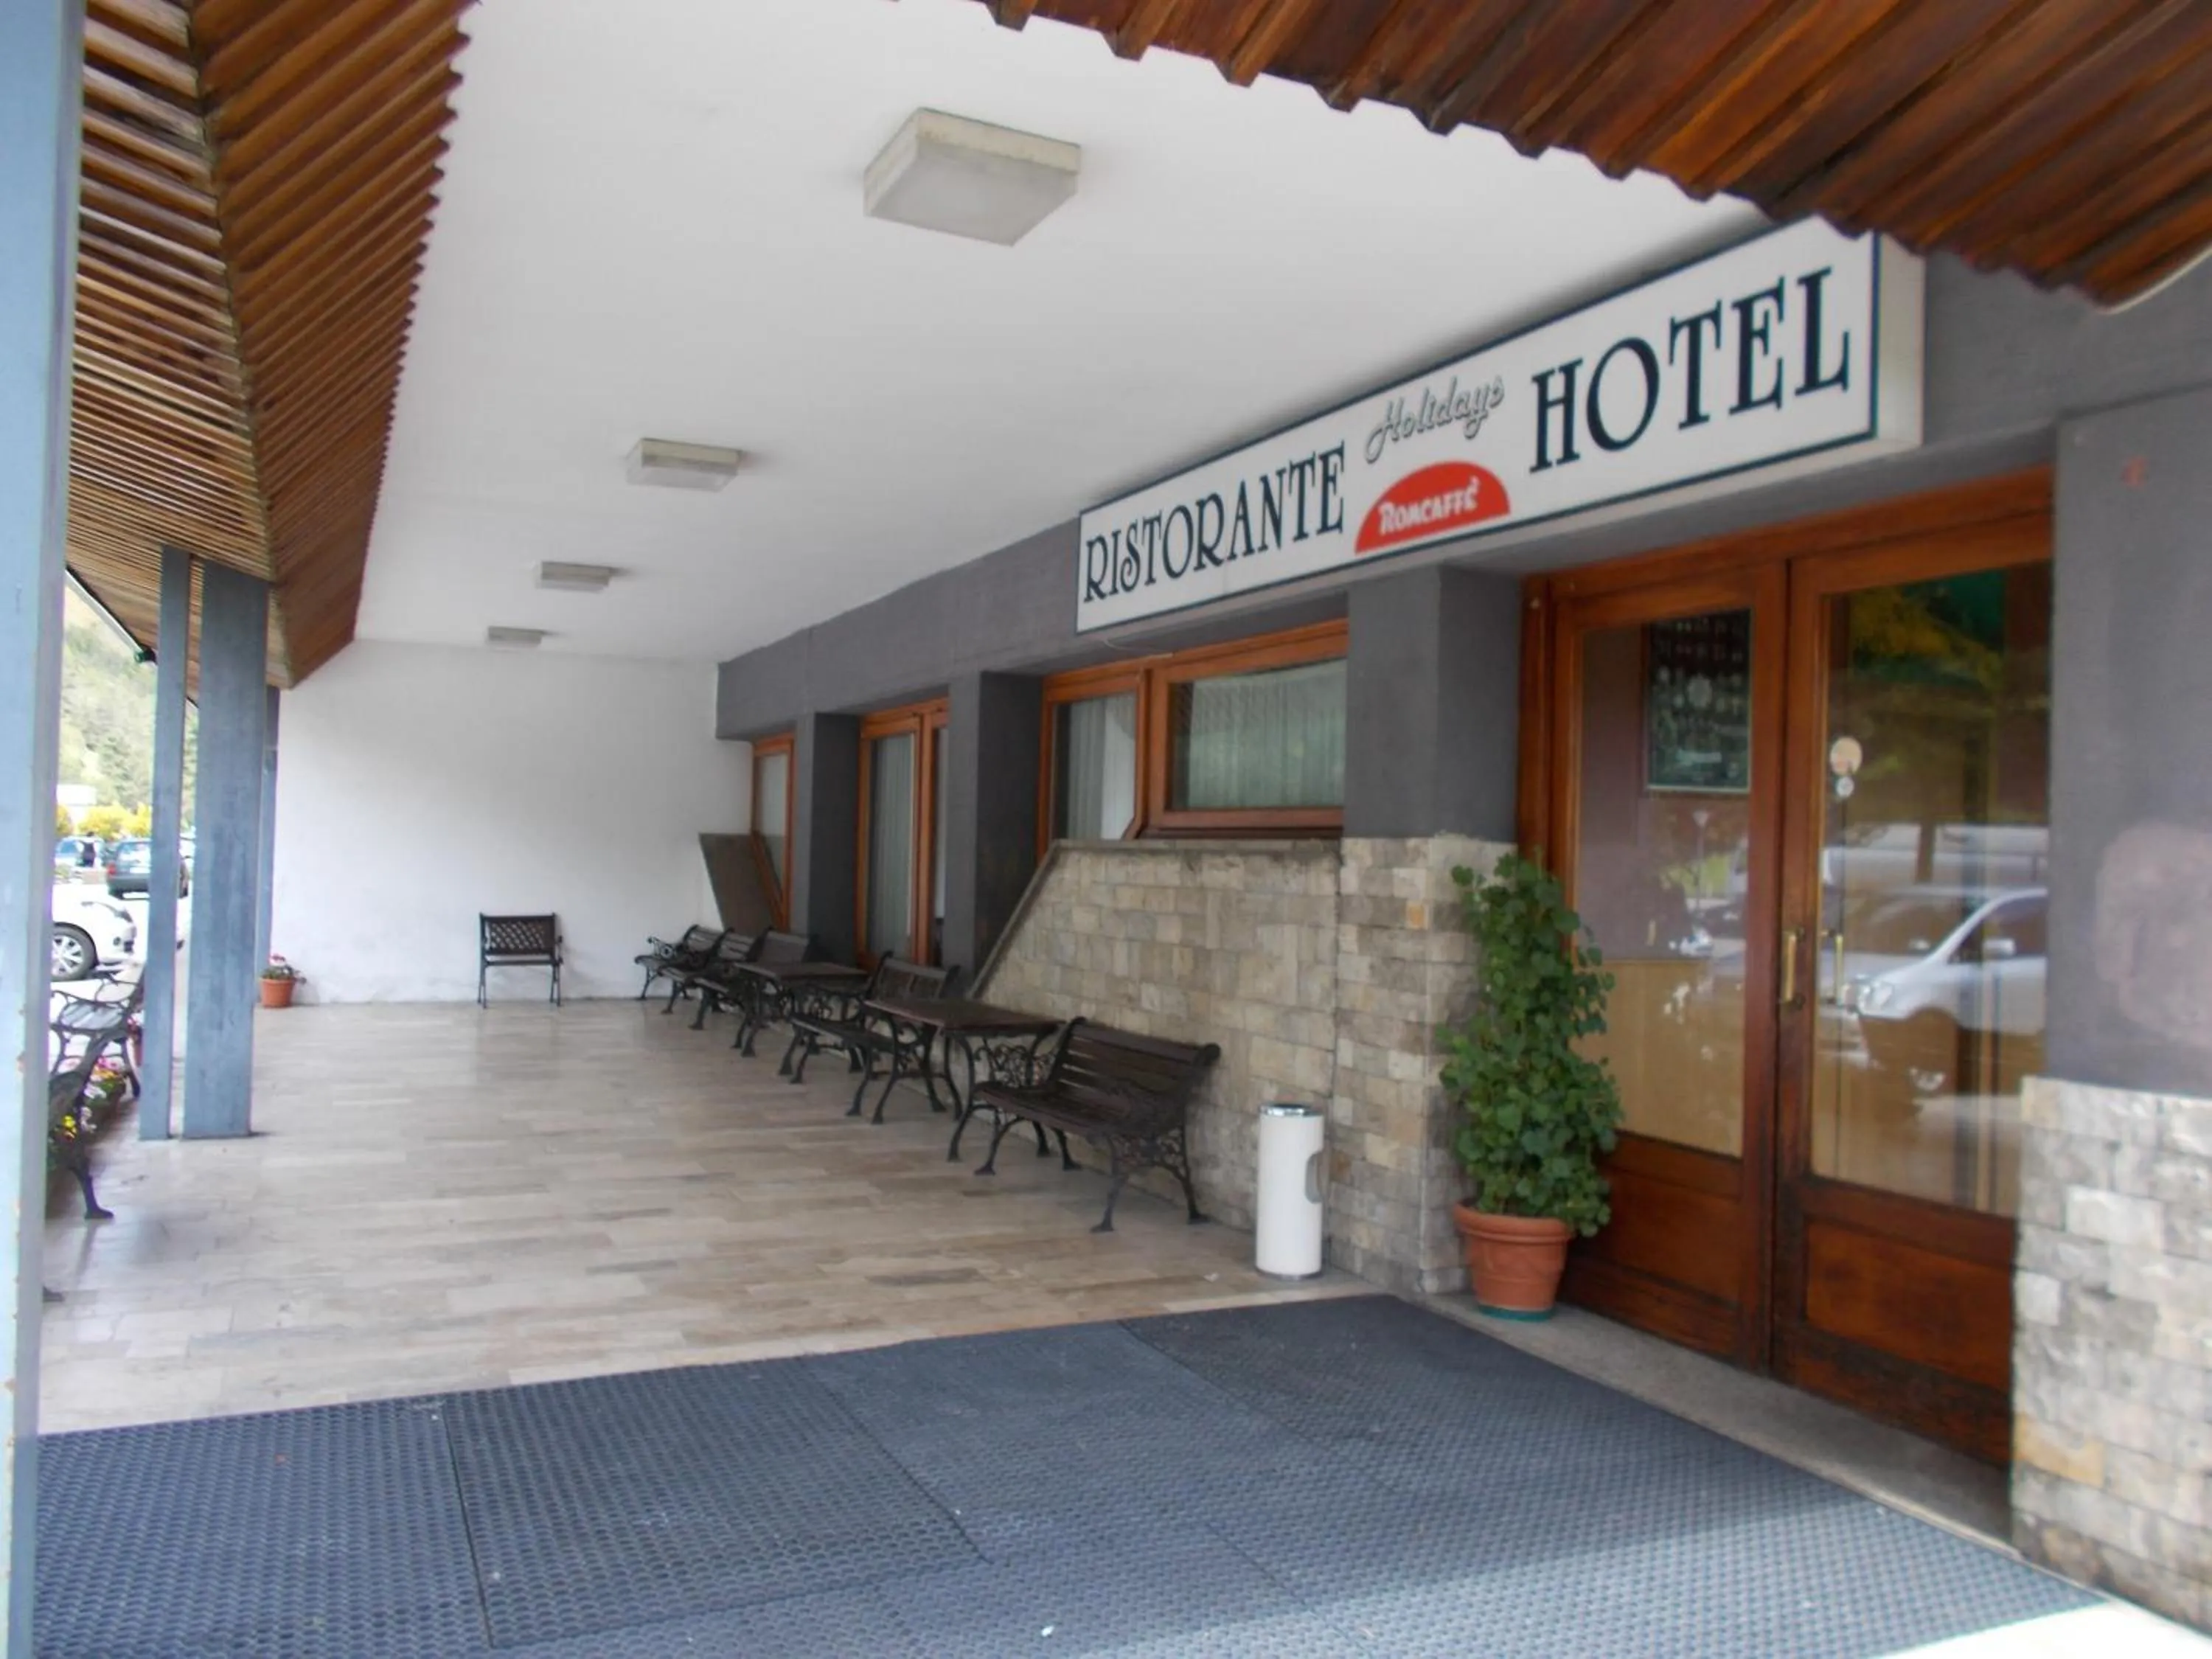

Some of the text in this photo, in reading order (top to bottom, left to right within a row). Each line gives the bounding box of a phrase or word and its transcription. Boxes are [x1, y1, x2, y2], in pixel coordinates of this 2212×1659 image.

[1366, 375, 1504, 465] Holidays
[1529, 265, 1850, 474] HOTEL
[1083, 440, 1346, 603] RISTORANTE
